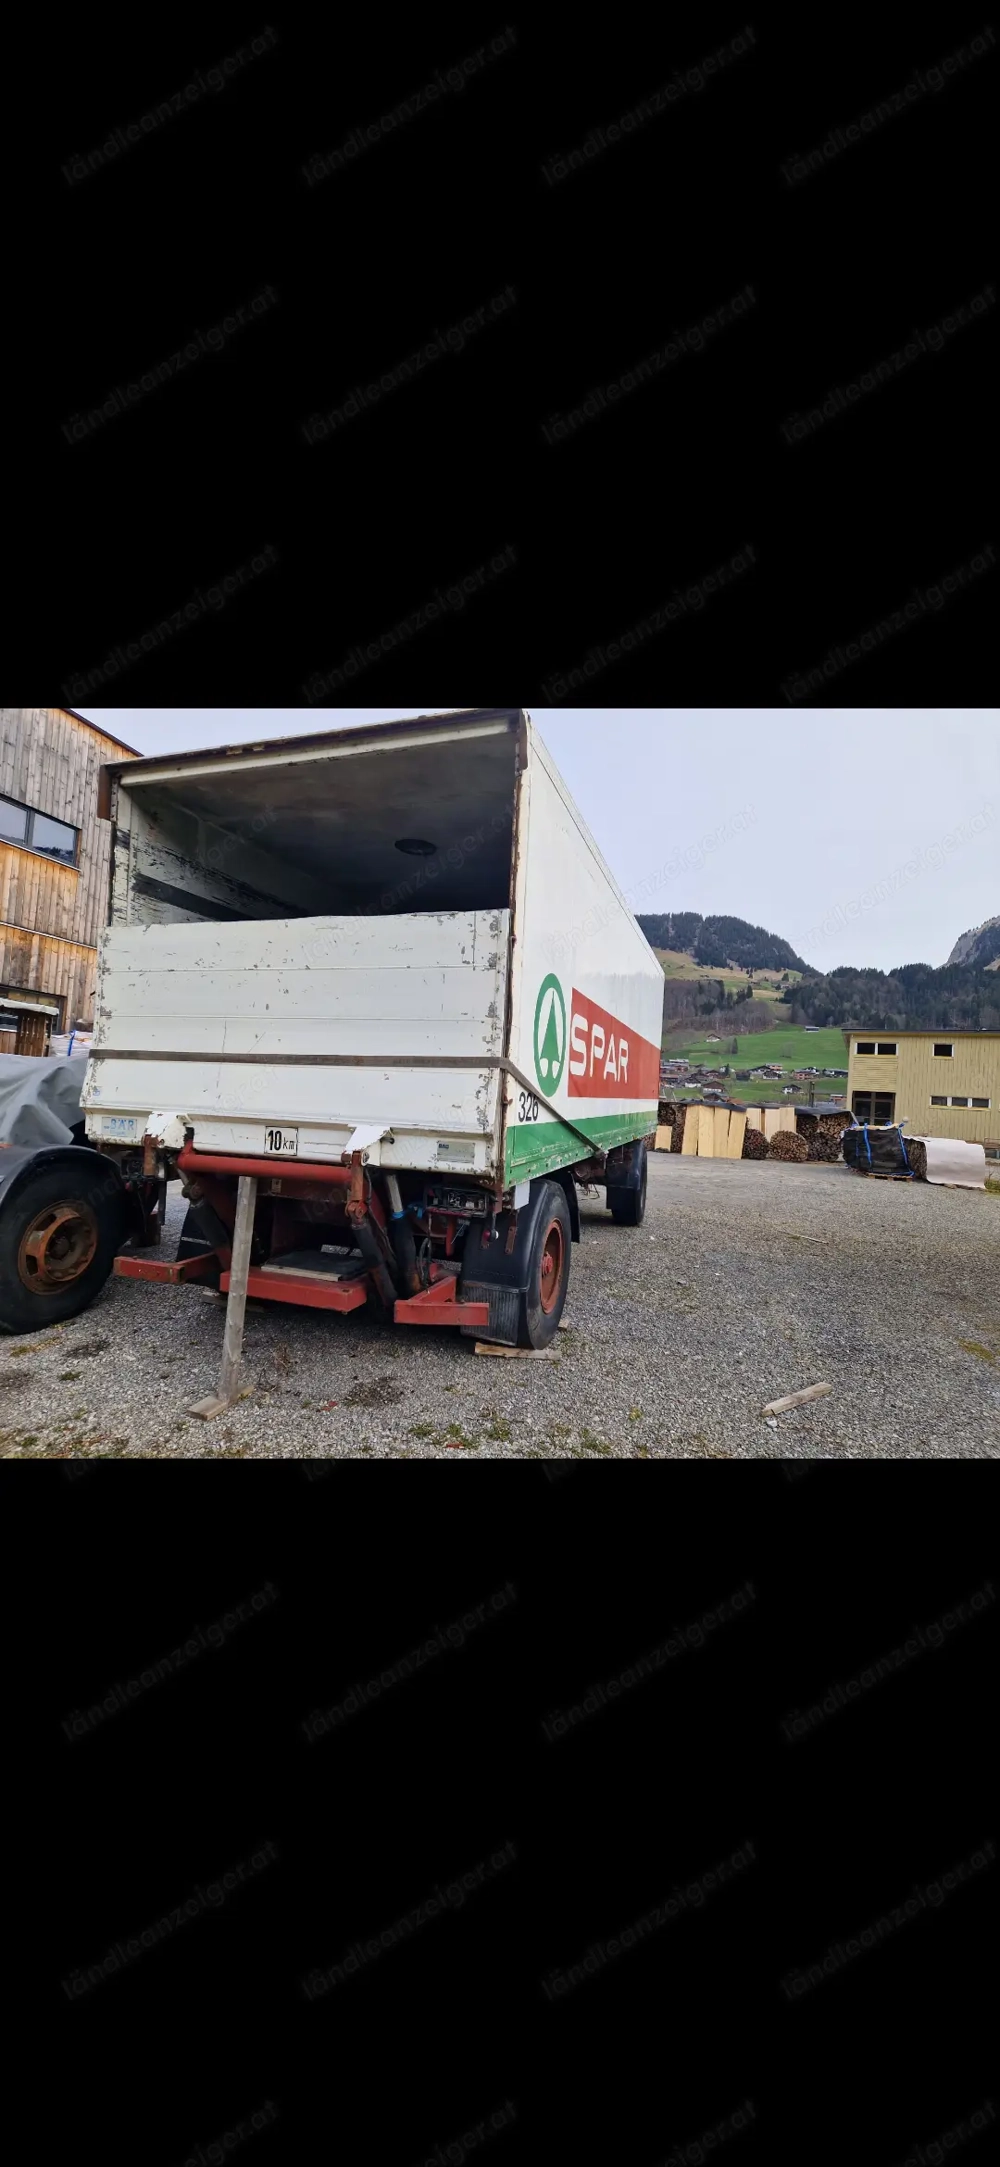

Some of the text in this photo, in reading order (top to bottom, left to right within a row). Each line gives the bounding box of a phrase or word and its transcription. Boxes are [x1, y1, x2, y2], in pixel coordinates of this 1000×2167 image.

[570, 1013, 629, 1084] SPAR
[518, 1091, 539, 1122] 326
[268, 1130, 295, 1151] 10 km
